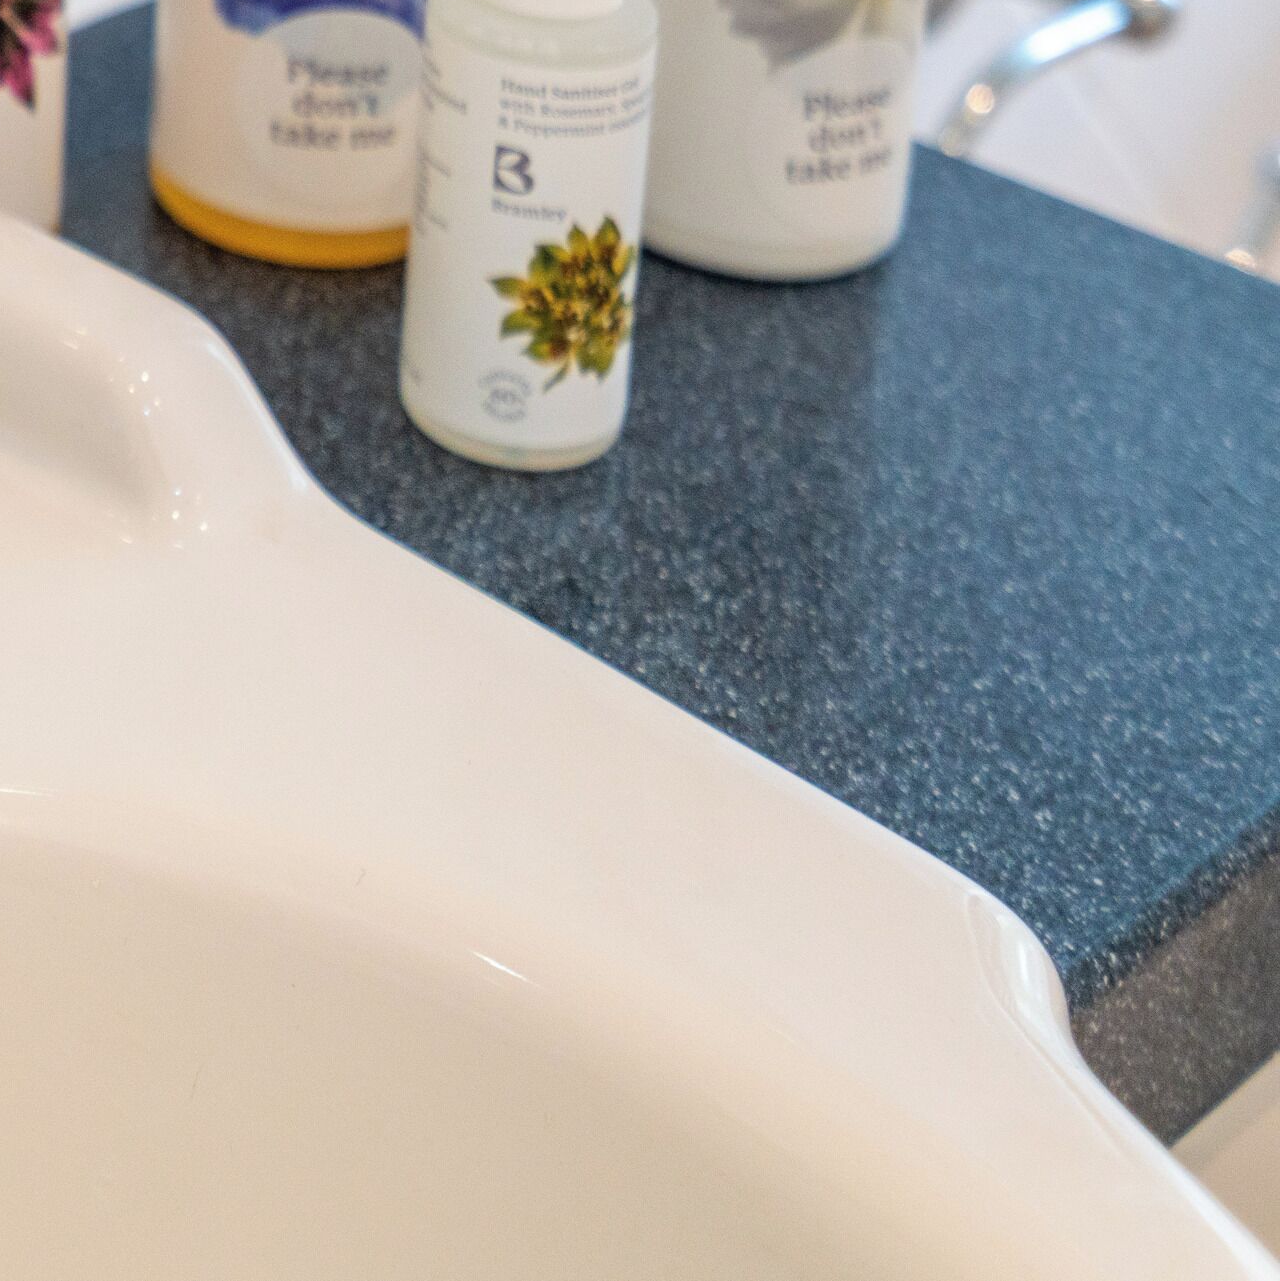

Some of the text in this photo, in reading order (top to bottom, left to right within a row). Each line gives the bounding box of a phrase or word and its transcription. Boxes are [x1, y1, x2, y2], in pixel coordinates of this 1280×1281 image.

[287, 54, 390, 87] Please
[499, 77, 547, 99] Hand
[803, 88, 892, 122] Please
[270, 120, 397, 152] take me
[493, 144, 535, 197] B
[785, 144, 893, 186] take me
[491, 198, 568, 222] Bramley
